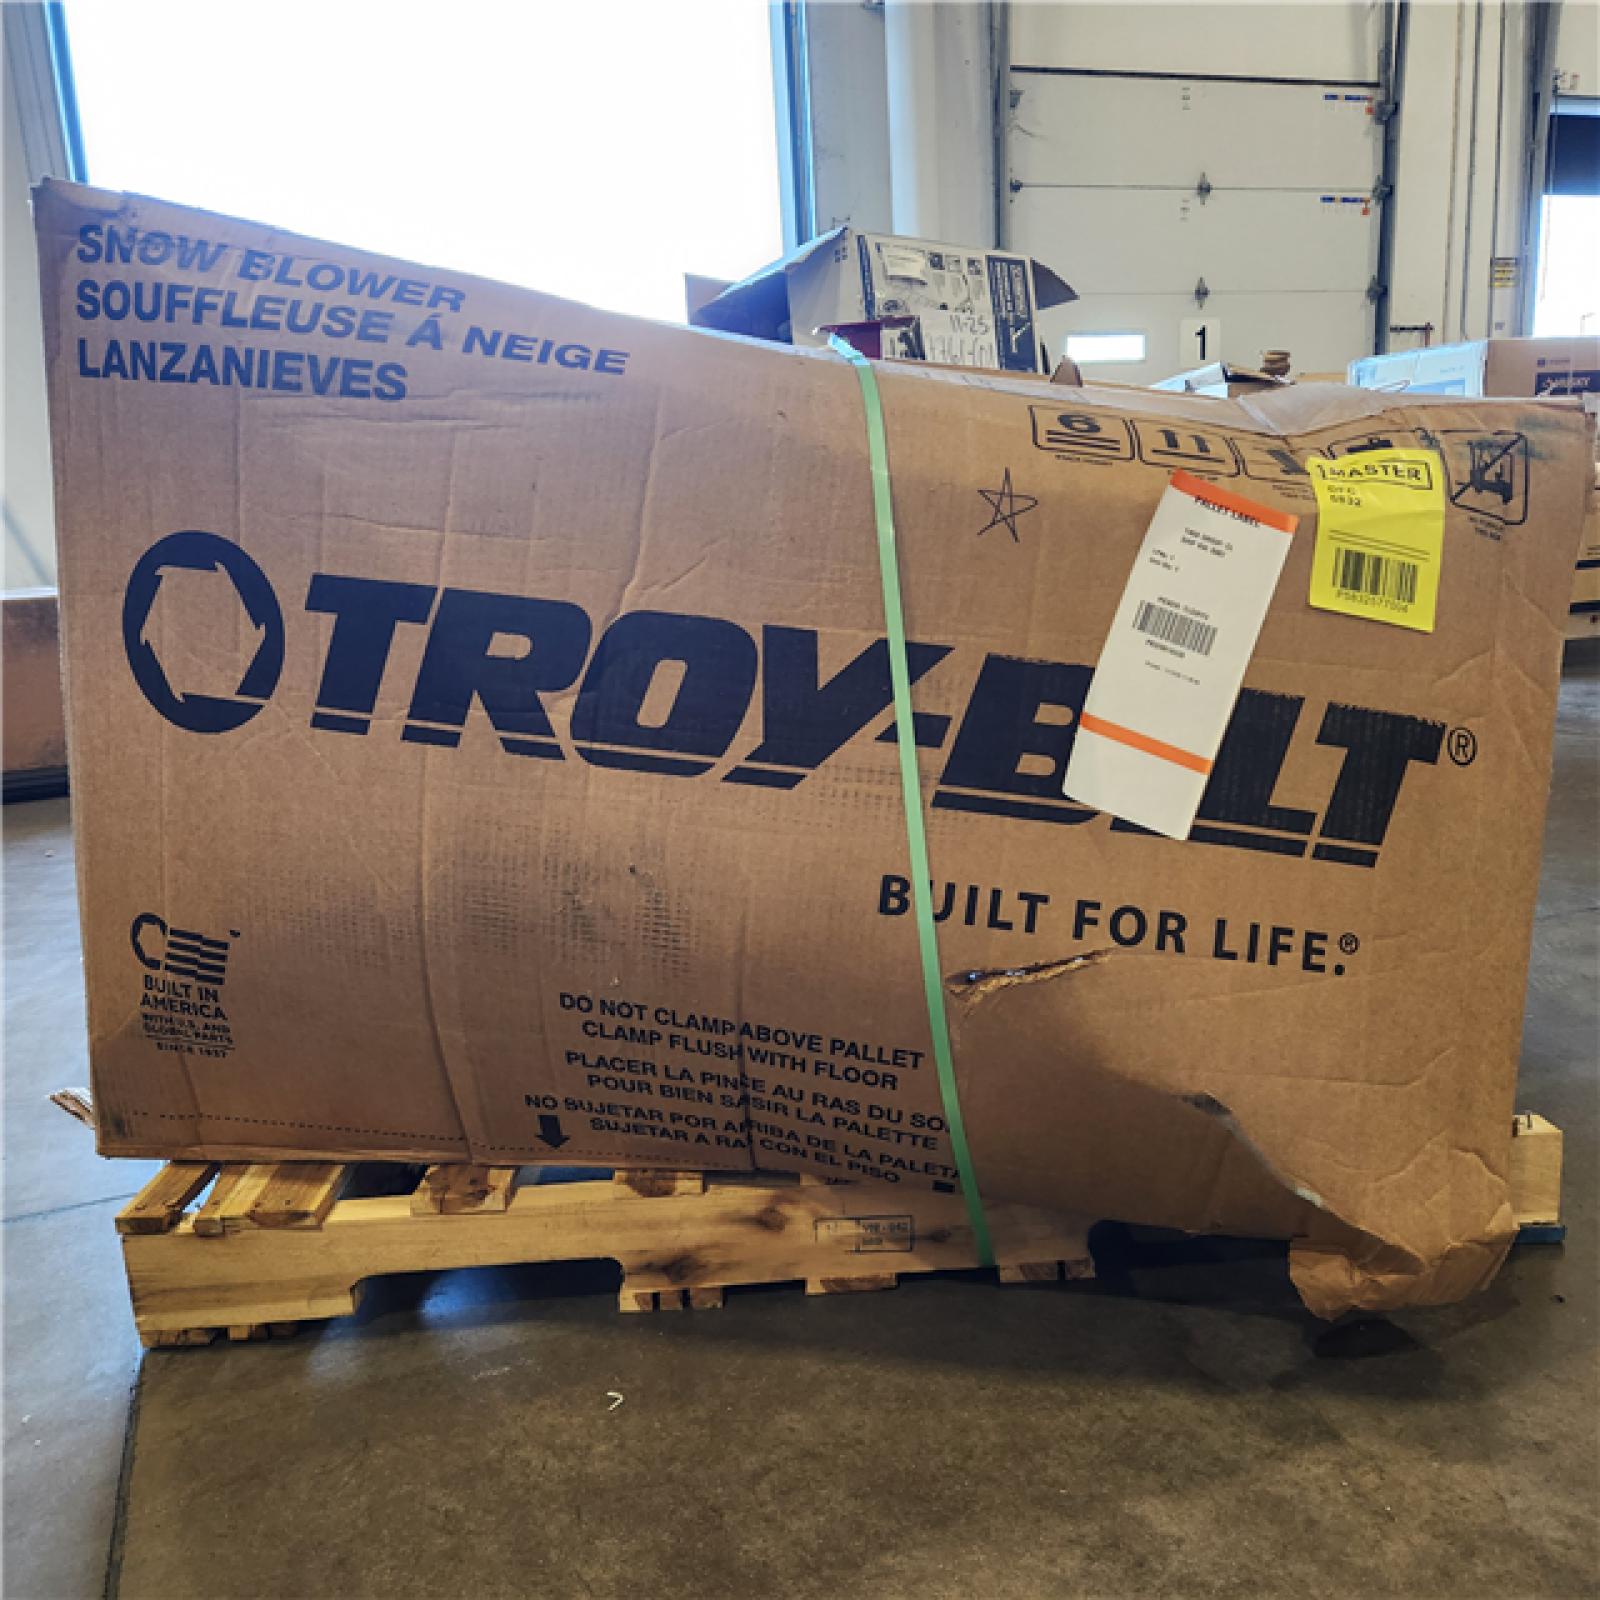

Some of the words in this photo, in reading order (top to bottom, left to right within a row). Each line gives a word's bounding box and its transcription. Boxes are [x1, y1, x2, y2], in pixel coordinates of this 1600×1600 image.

[77, 223, 227, 271] SNOW
[238, 248, 465, 312] BLOWER
[77, 279, 395, 343] SOUFFLEUSE
[462, 326, 630, 374] NEIGE
[1195, 325, 1206, 360] 1
[78, 338, 408, 400] LANZANIEVES
[1072, 899, 1187, 954] FOR
[140, 992, 228, 1020] AMERICA
[144, 974, 192, 999] BUILT
[198, 987, 219, 1003] IN
[560, 991, 593, 1013] DO
[600, 999, 648, 1021] NOT
[655, 1007, 736, 1036] CLAMP
[740, 1021, 823, 1053] ABOVE
[829, 1038, 925, 1070] PALLET
[582, 1020, 662, 1046] CLAMP
[669, 1034, 743, 1061] FLUSH
[748, 1046, 807, 1073] WITH
[814, 1060, 898, 1091] FLOOR
[565, 1051, 657, 1077] PLACER
[664, 1065, 695, 1083] LA
[772, 1084, 804, 1102] AU
[812, 1092, 860, 1115] RAS
[868, 1105, 903, 1124] DU
[910, 1112, 950, 1132] SO
[587, 1075, 653, 1095] POUR
[659, 1084, 713, 1105] BIEN
[797, 1107, 826, 1126] LA
[832, 1116, 938, 1150] PALETTE
[525, 1094, 558, 1110] NO
[565, 1097, 664, 1122] SUJETAR
[670, 1112, 716, 1131] POR
[807, 1134, 836, 1151] DE
[844, 1144, 872, 1161] LA
[590, 1117, 688, 1142] SUJETAR
[694, 1132, 711, 1145] A
[759, 1139, 809, 1159] CON
[814, 1151, 842, 1166] EL
[848, 1159, 900, 1184] PISO
